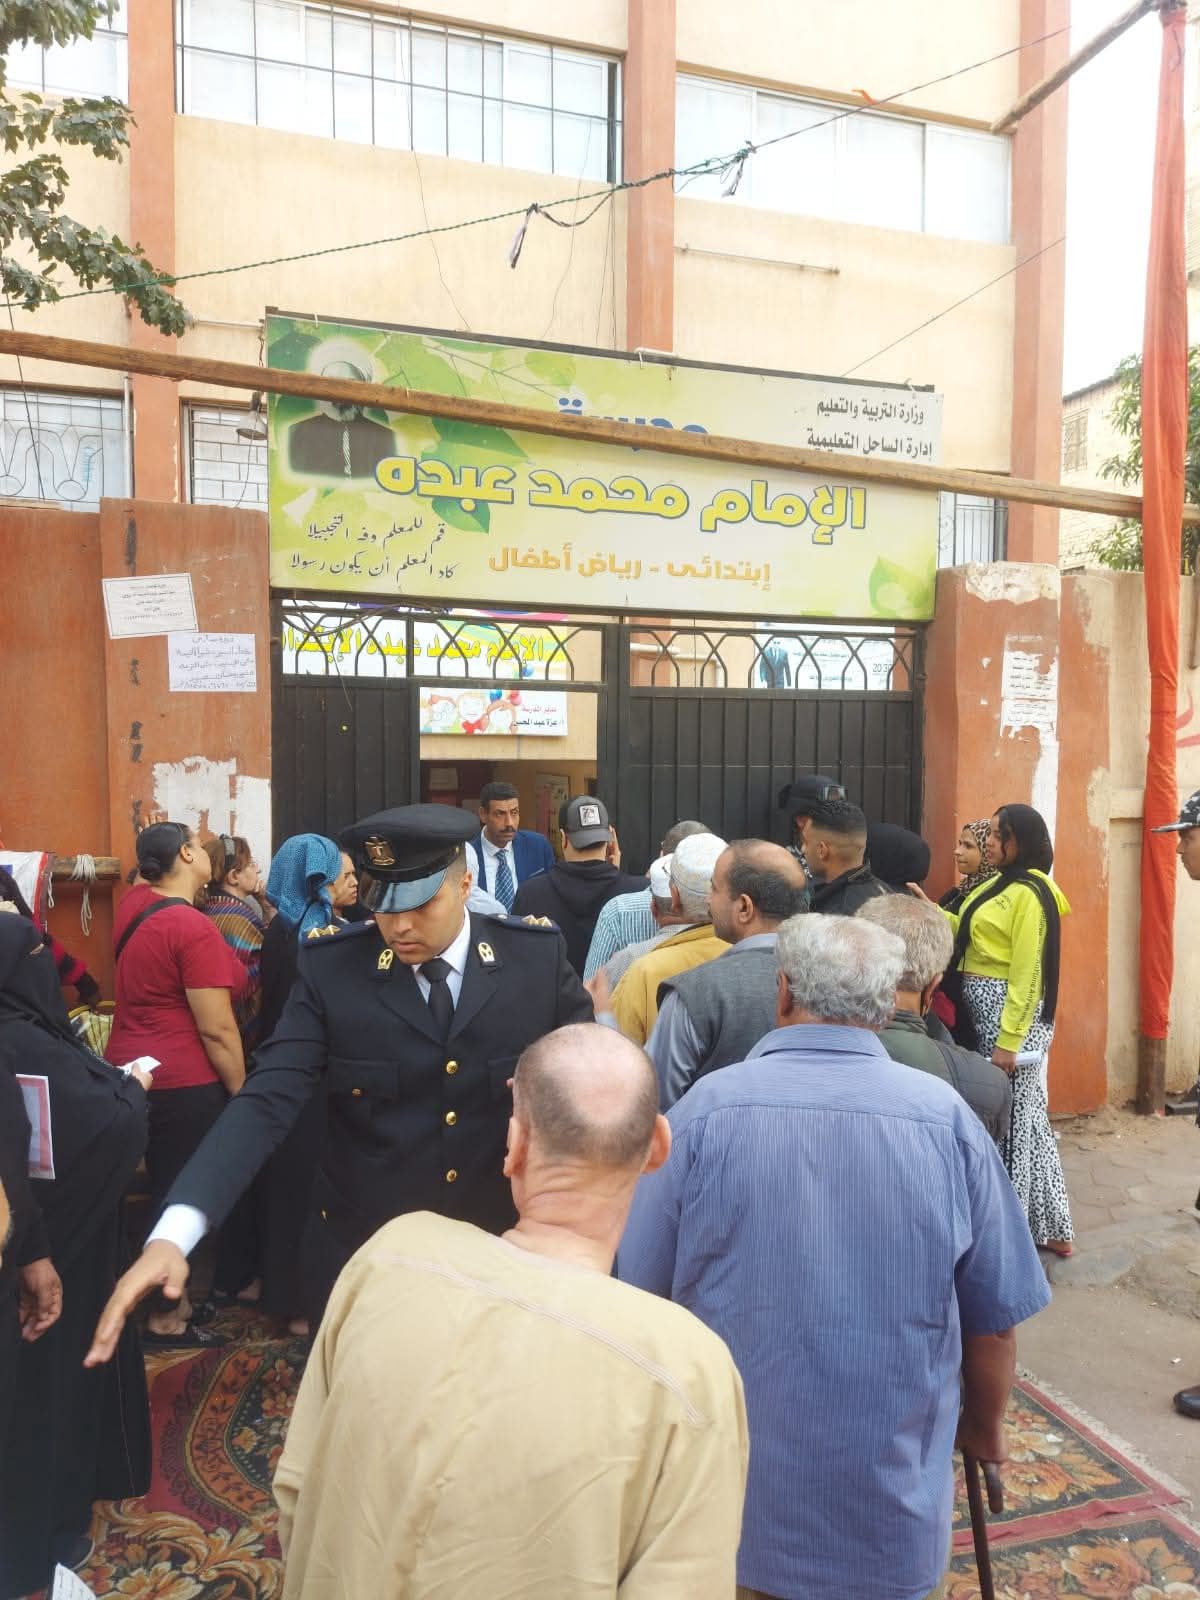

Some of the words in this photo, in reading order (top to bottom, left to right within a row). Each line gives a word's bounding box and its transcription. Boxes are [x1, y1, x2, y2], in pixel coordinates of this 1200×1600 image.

[816, 397, 859, 419] والتعليم
[861, 398, 897, 422] التربية
[899, 403, 924, 425] وزارة
[806, 427, 860, 452] التعليمية
[862, 434, 903, 455] الساحل
[906, 437, 933, 462] إدارة
[375, 456, 516, 514] عبده
[528, 470, 690, 519] محمد
[699, 479, 867, 545] الإمام
[488, 542, 573, 572] أطفال
[577, 551, 642, 580] رياض
